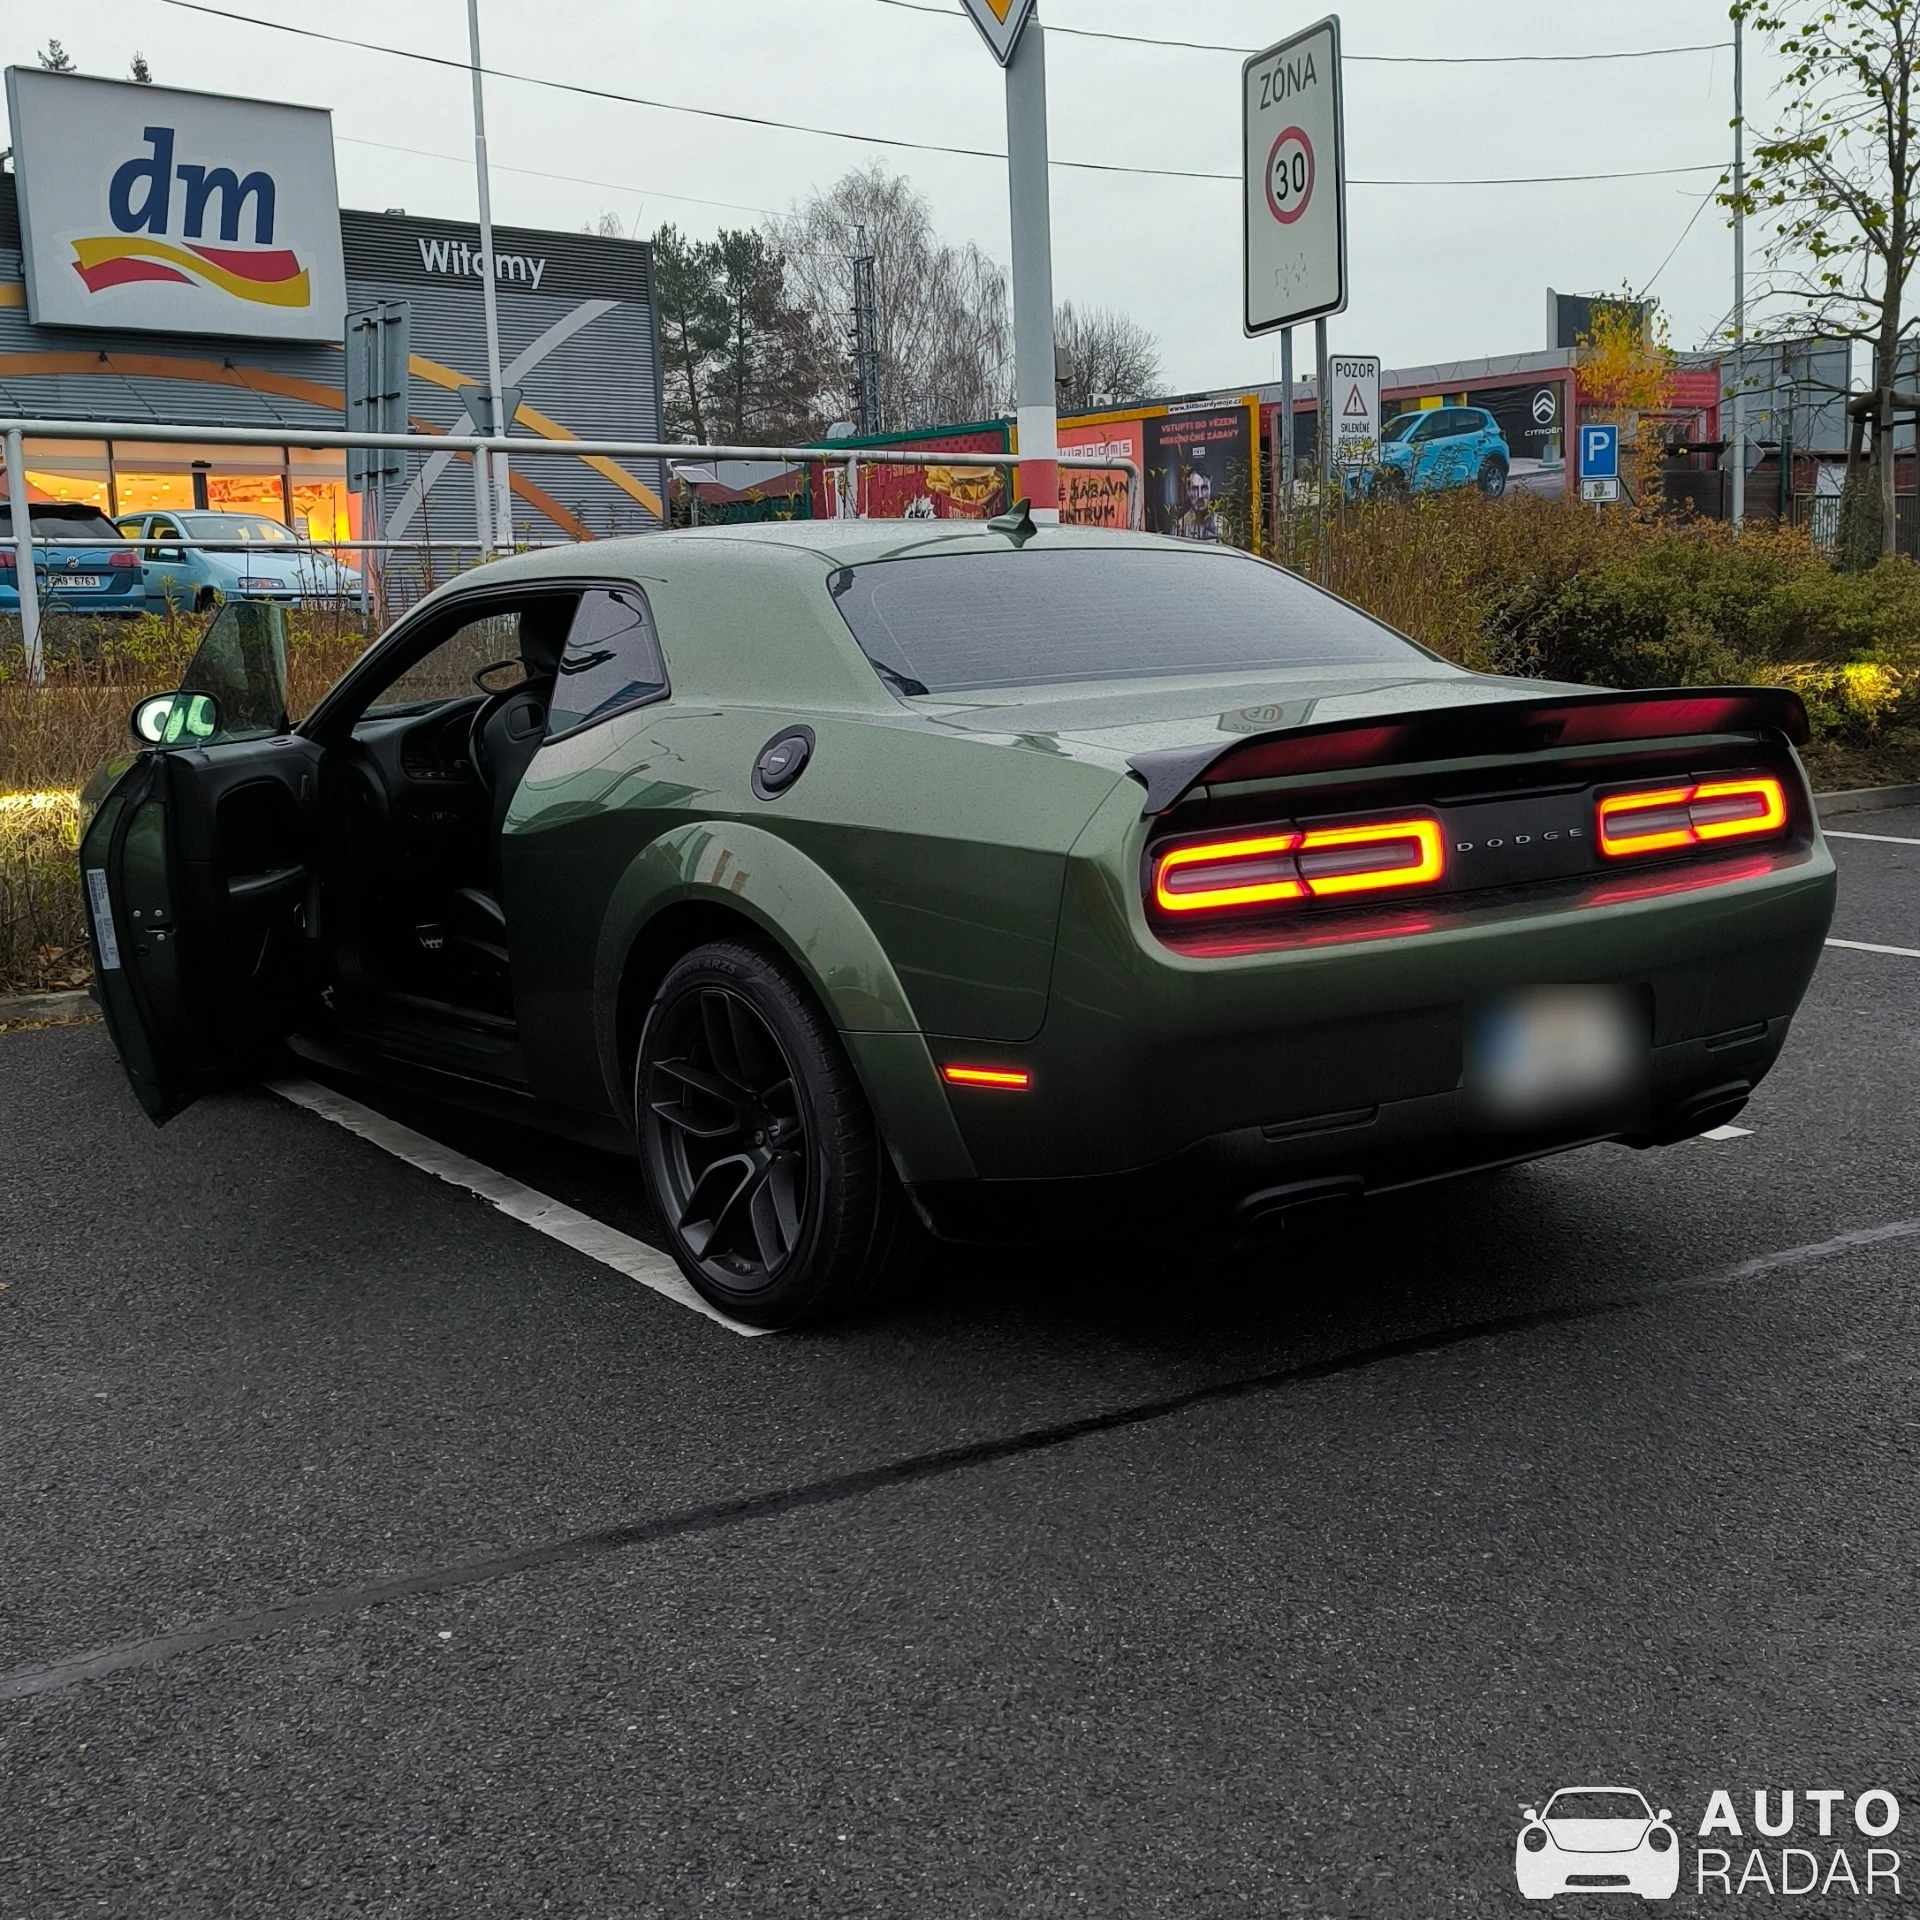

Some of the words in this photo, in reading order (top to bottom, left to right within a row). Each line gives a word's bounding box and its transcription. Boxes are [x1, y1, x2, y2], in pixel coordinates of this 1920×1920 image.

[1260, 52, 1317, 110] ZÓNA
[109, 127, 275, 244] dm
[1276, 152, 1305, 200] 30
[1335, 362, 1375, 378] POZOR
[1589, 431, 1610, 461] P
[74, 576, 96, 586] 6763
[1456, 828, 1583, 852] DODGE
